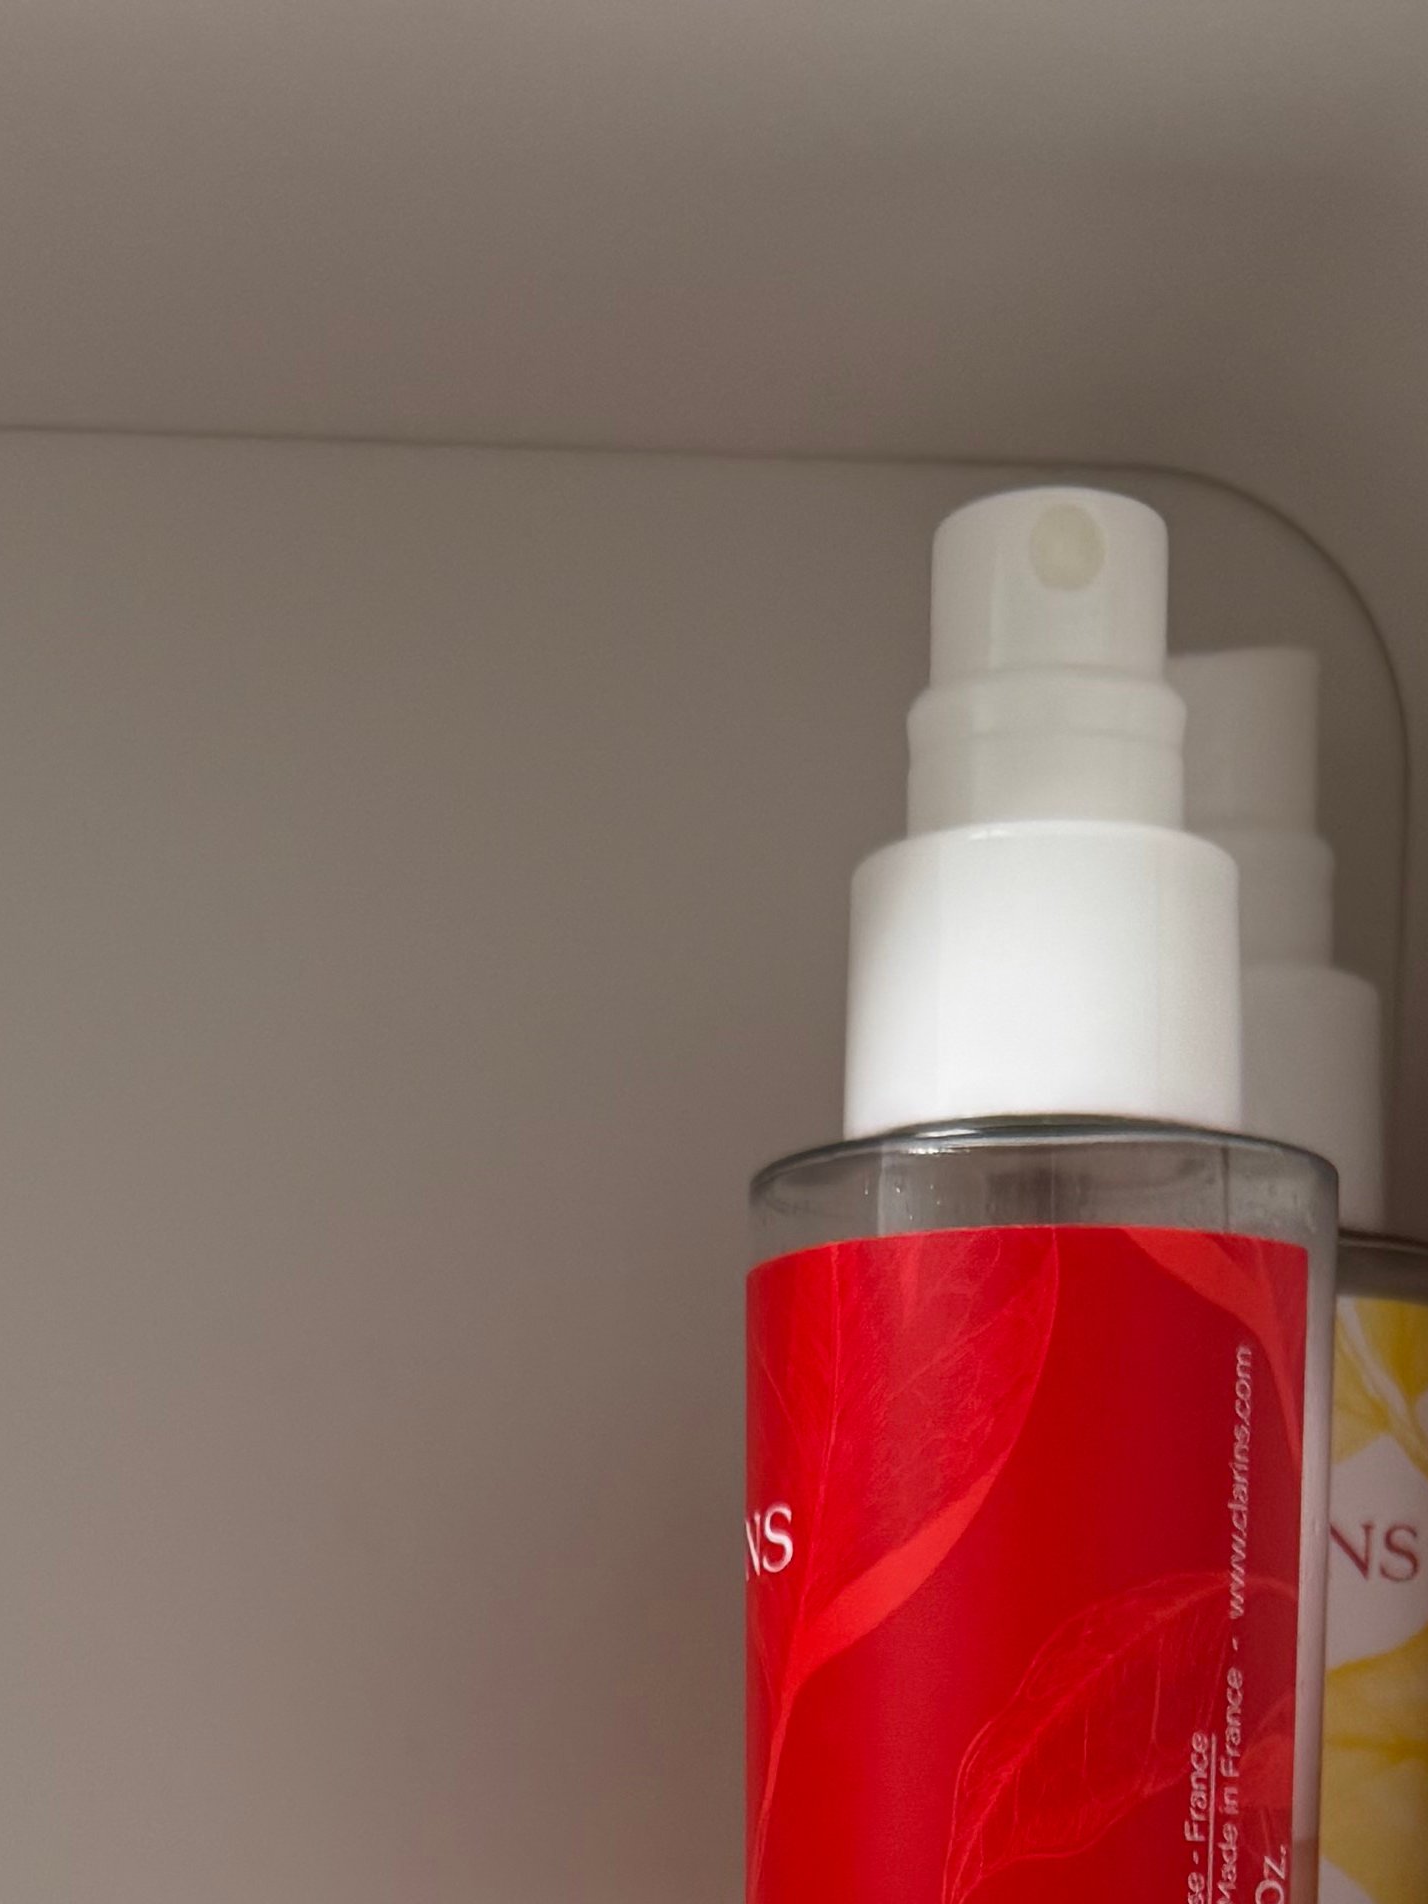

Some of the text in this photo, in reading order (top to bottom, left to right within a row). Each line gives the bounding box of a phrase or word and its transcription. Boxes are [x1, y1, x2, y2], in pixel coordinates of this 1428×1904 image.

[1227, 1345, 1251, 1619] www.clarins.com
[1220, 1667, 1243, 1777] France
[1184, 1732, 1209, 1842] France
[1219, 1786, 1239, 1815] in
